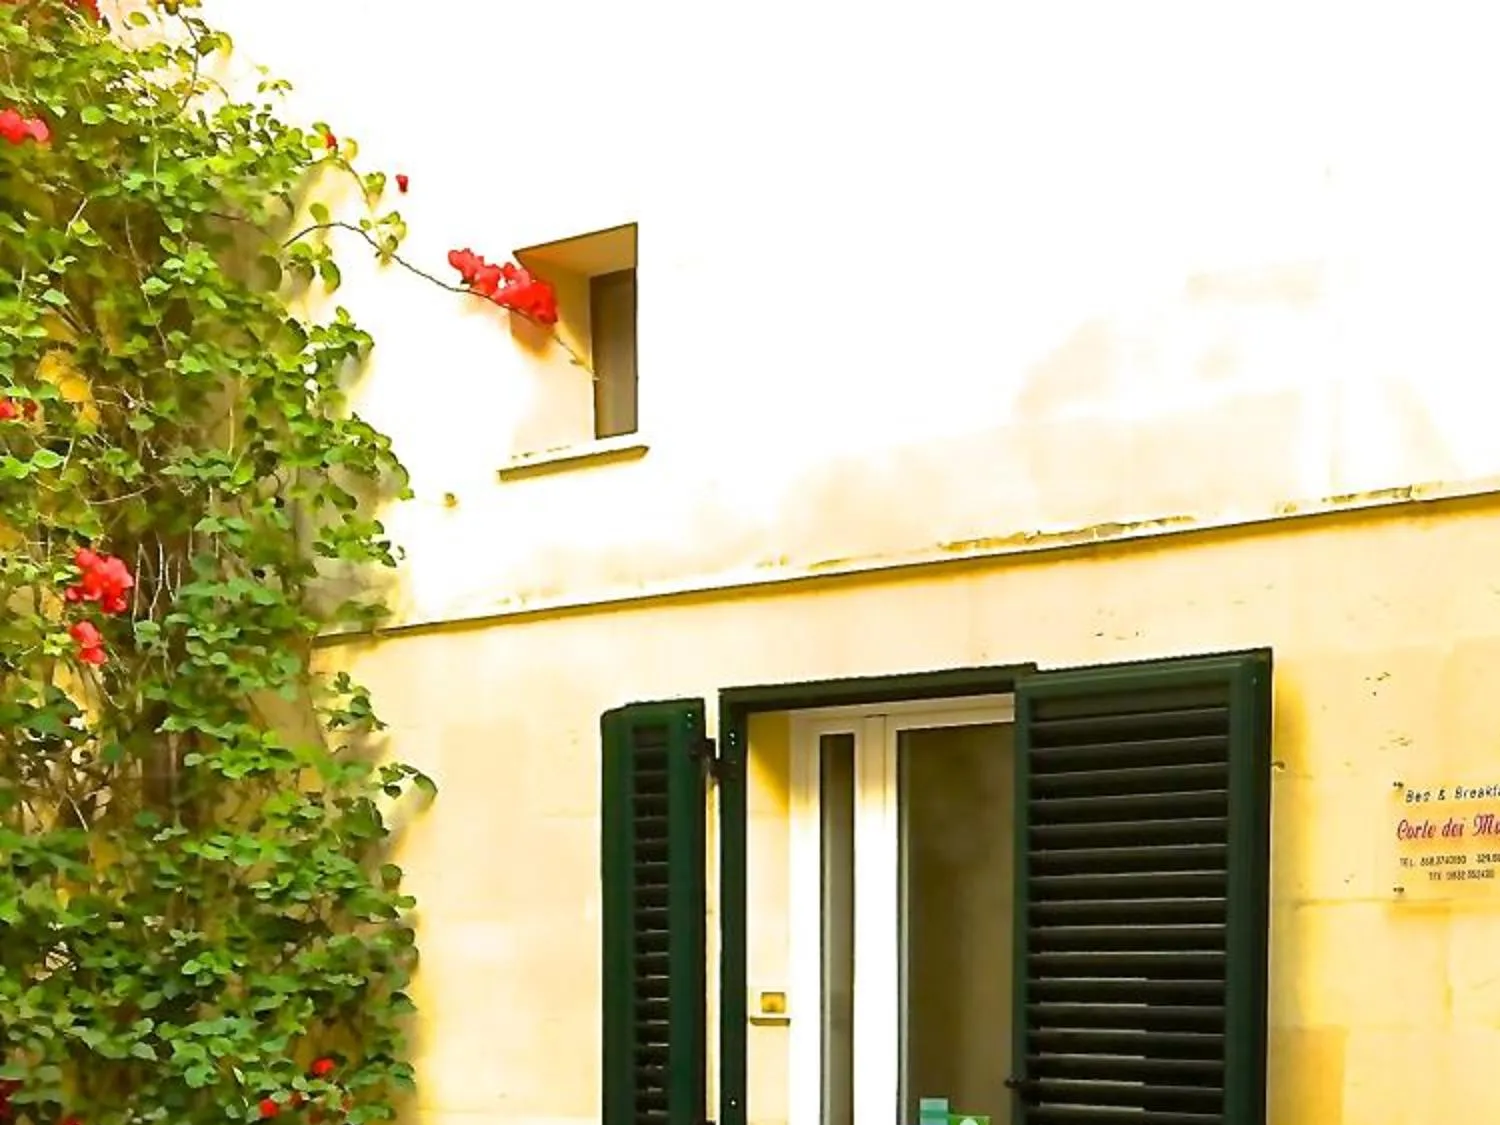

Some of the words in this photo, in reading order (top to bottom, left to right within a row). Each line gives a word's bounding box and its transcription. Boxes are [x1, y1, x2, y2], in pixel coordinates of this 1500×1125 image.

[1437, 789, 1446, 801] &
[1396, 818, 1437, 841] Corte
[1441, 816, 1466, 838] dei
